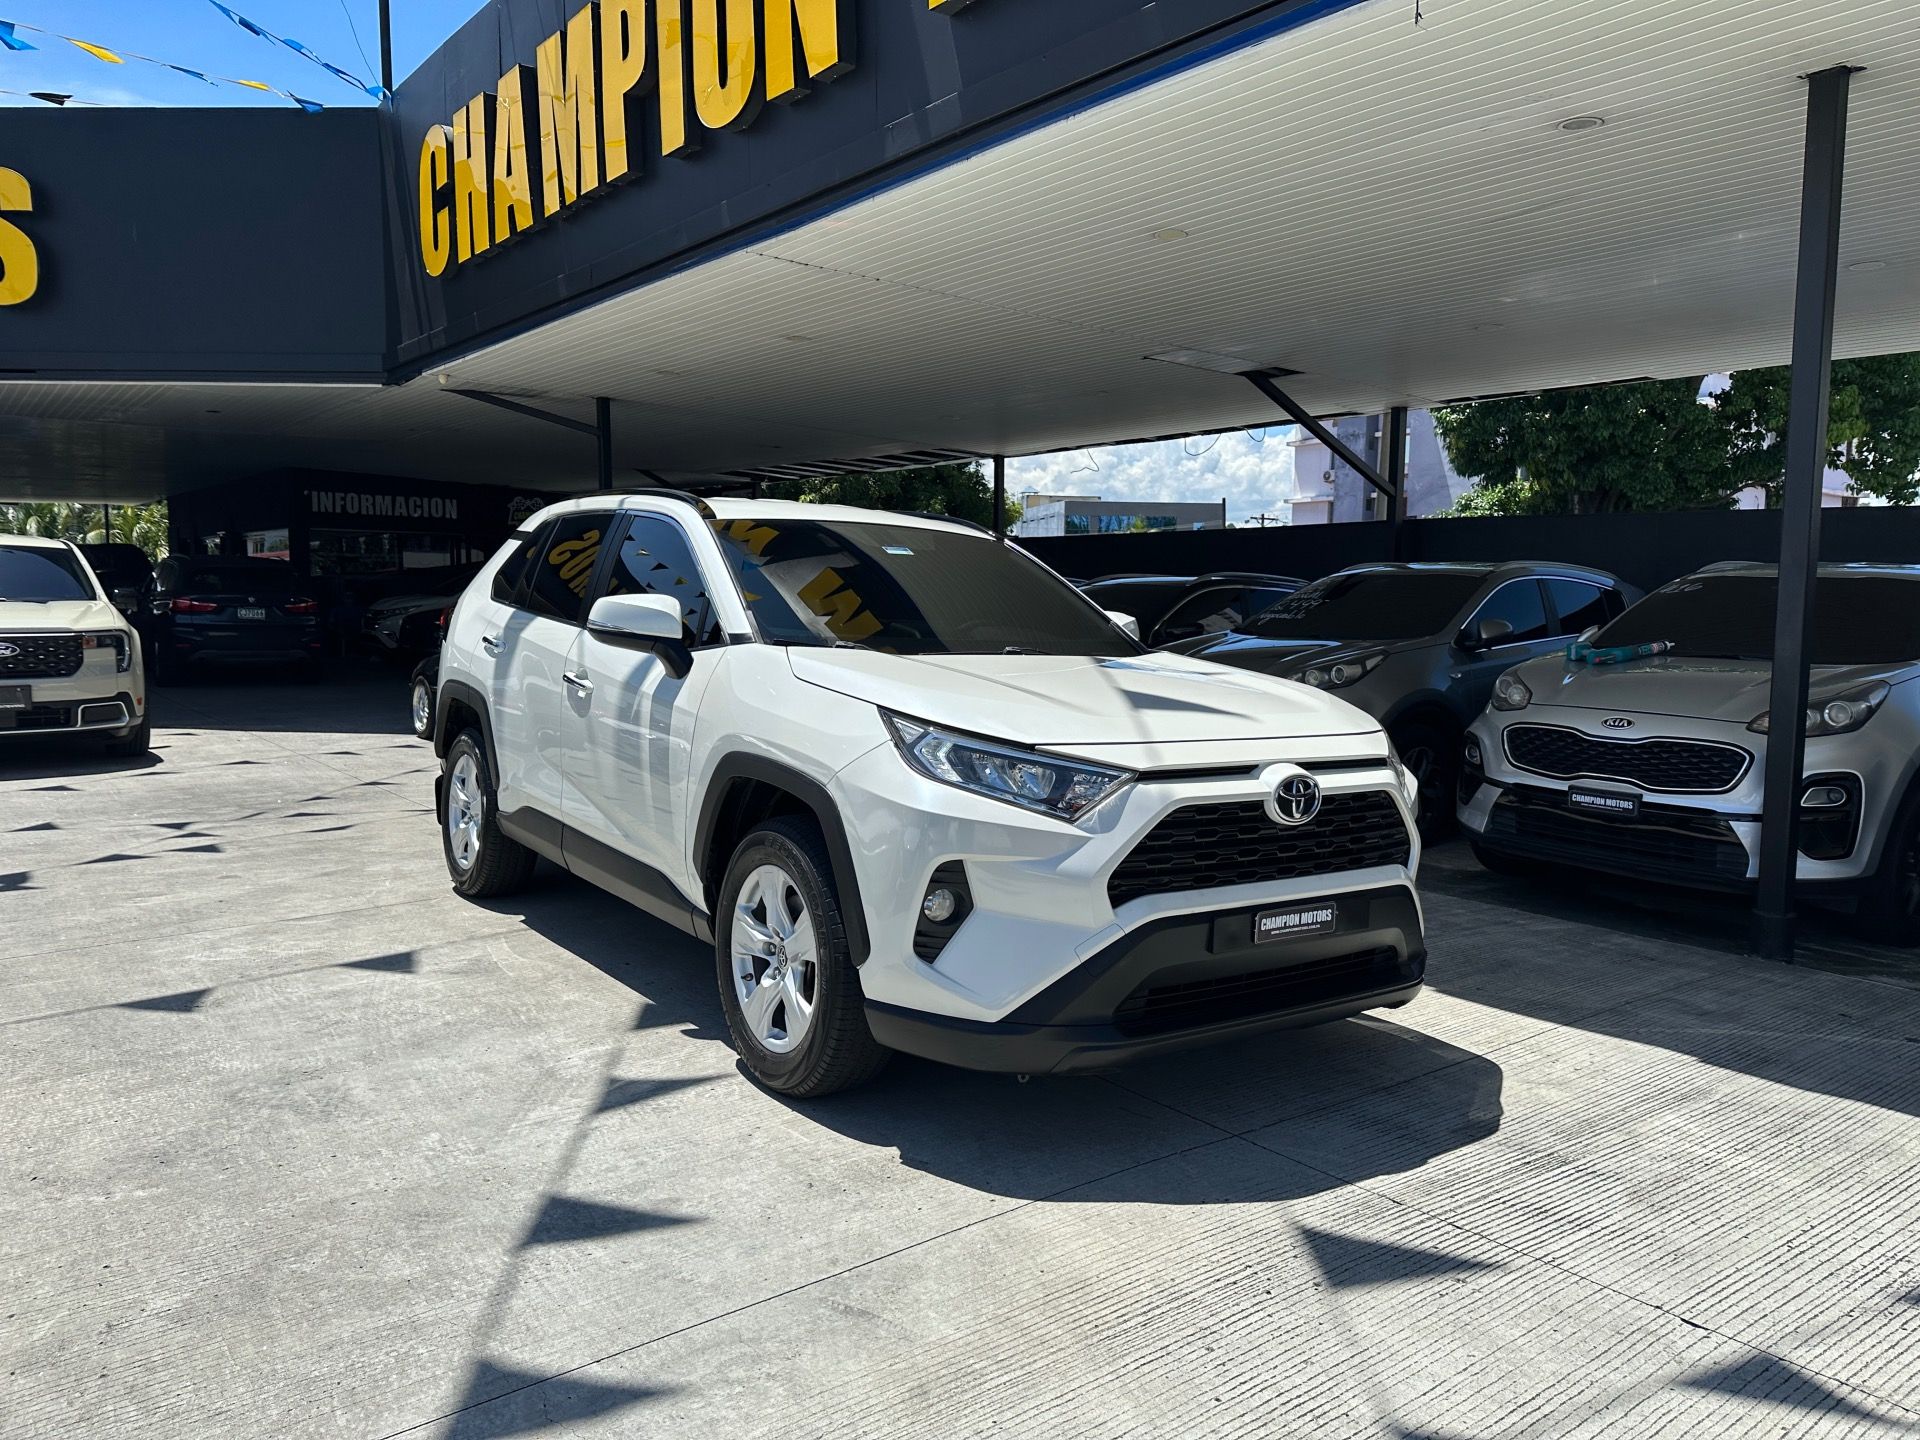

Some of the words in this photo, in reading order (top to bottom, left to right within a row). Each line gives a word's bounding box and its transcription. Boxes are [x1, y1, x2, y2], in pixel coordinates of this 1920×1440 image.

[311, 490, 459, 520] INFORMACION
[1606, 718, 1628, 727] KIA
[1571, 793, 1605, 806] CHAMPION
[1605, 798, 1633, 809] MOTORS
[1260, 913, 1300, 931] CHAMPION
[1300, 908, 1332, 925] MOTORS
